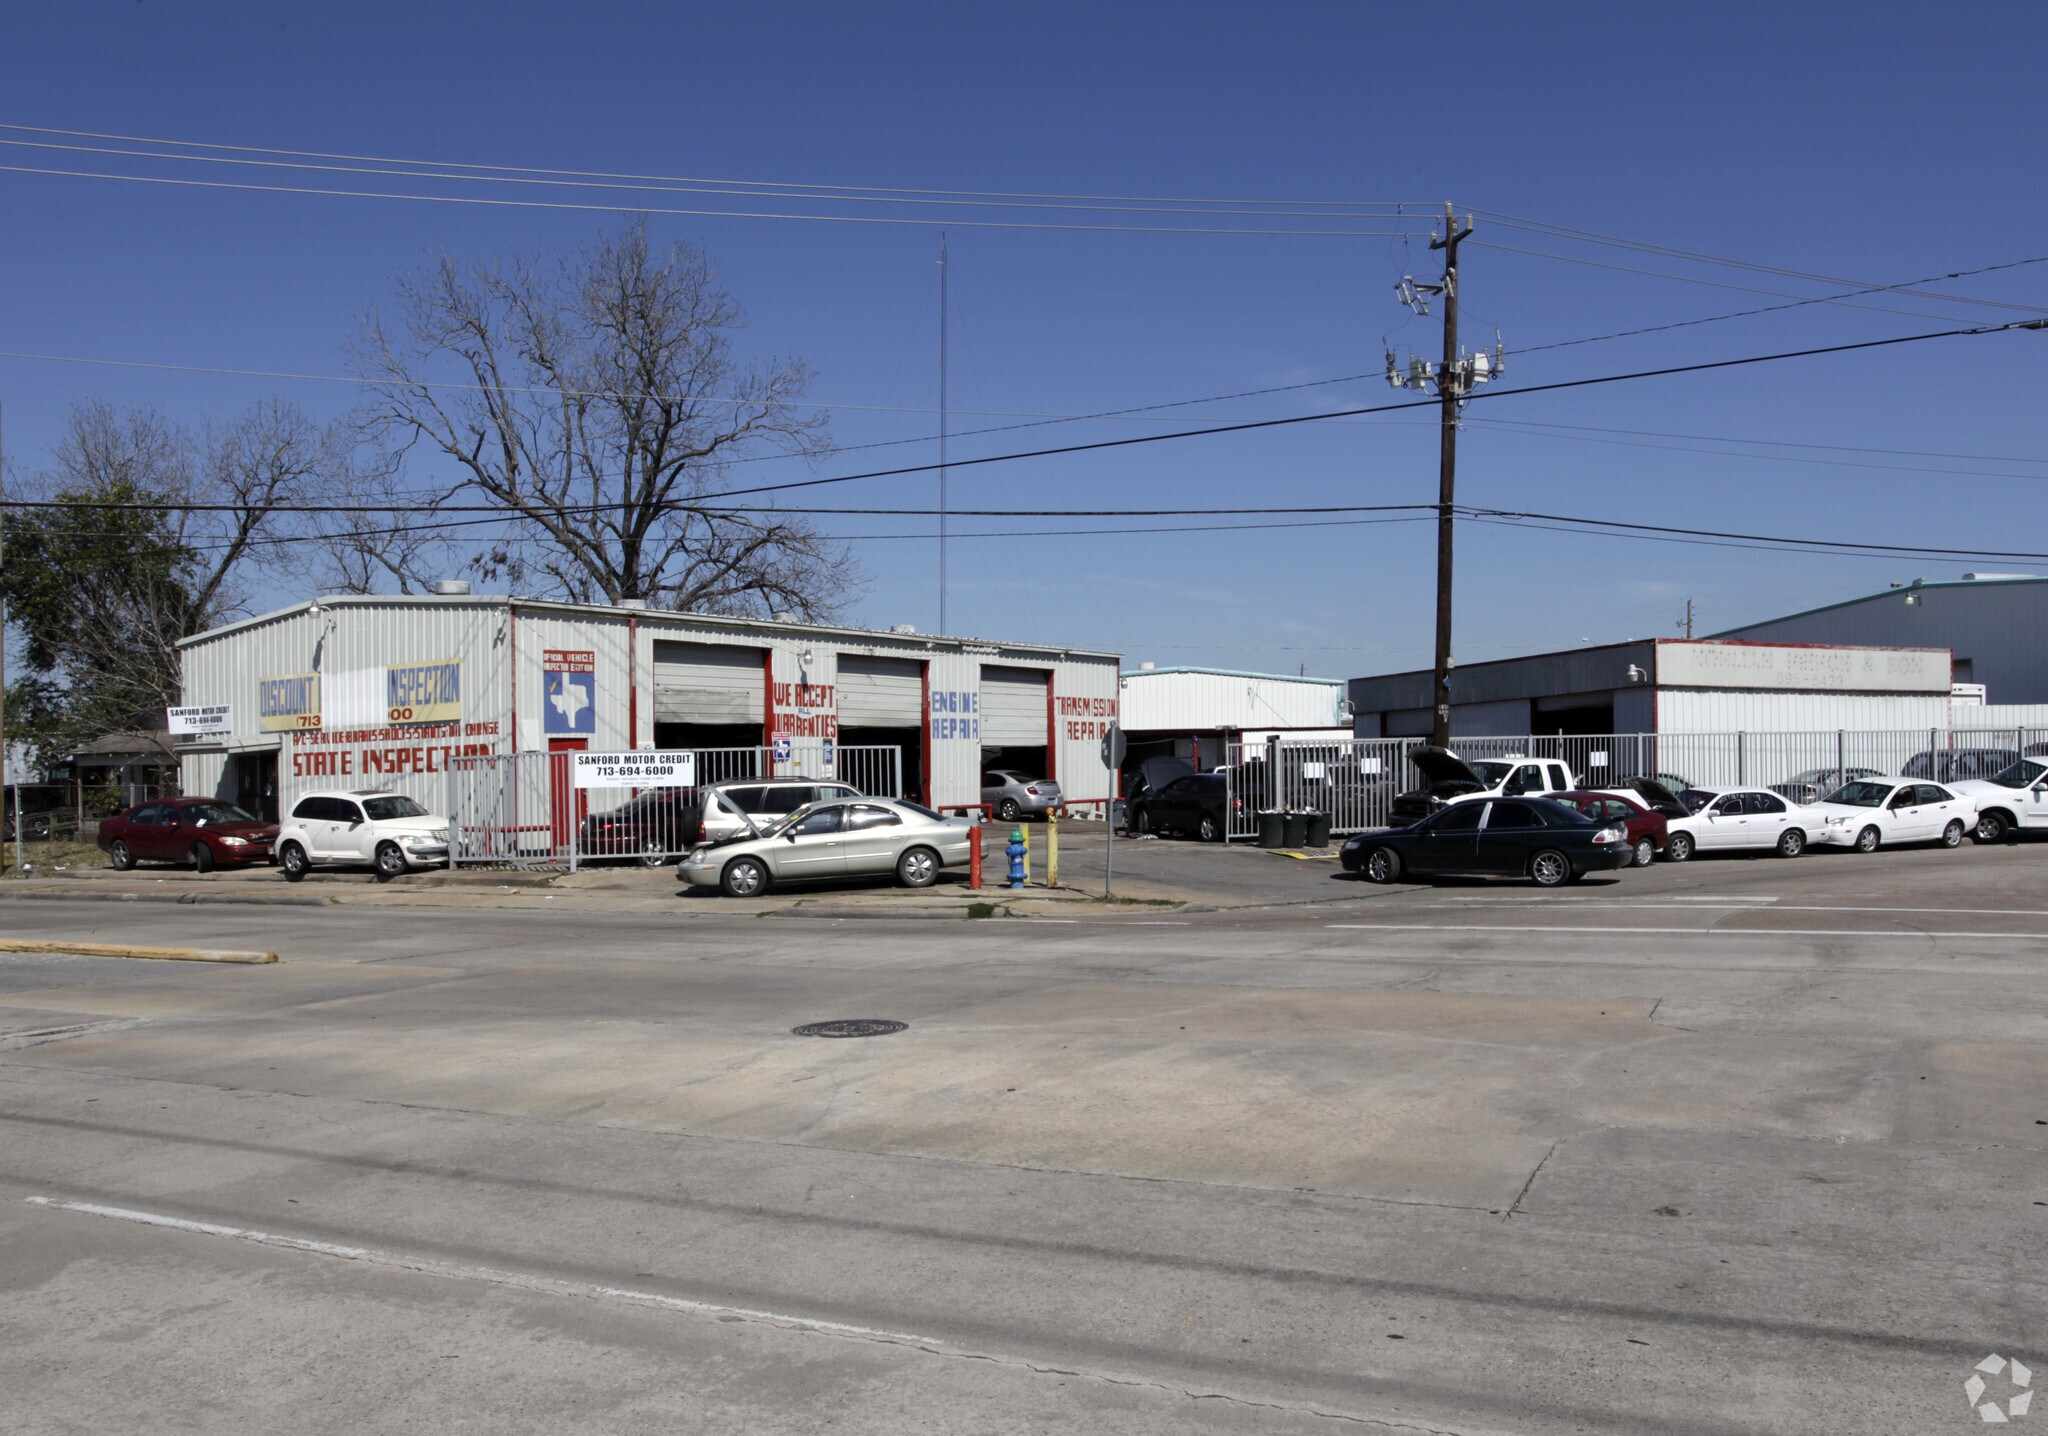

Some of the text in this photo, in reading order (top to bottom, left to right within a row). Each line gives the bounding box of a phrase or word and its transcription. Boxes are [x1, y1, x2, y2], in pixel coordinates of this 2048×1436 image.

[566, 653, 594, 662] VEHICLE
[260, 677, 314, 717] DISCOUNT
[387, 663, 460, 708] INSPECTION
[774, 682, 834, 708] WE ACCEPT
[798, 707, 810, 715] ALL
[931, 691, 978, 713] ENGINE
[1055, 696, 1116, 717] TRANSMISSION
[170, 706, 230, 717] SANFORD MOTOR CREDIT
[184, 715, 223, 725] 713-694-6000
[465, 721, 499, 737] CHANGE
[932, 718, 979, 739] REPAIR
[1067, 720, 1106, 740] REPAIR
[293, 743, 496, 777] STATE INSPECTION
[578, 754, 691, 765] SANFORD MOTOR CREDIT
[596, 766, 674, 776] 713-694-6000
